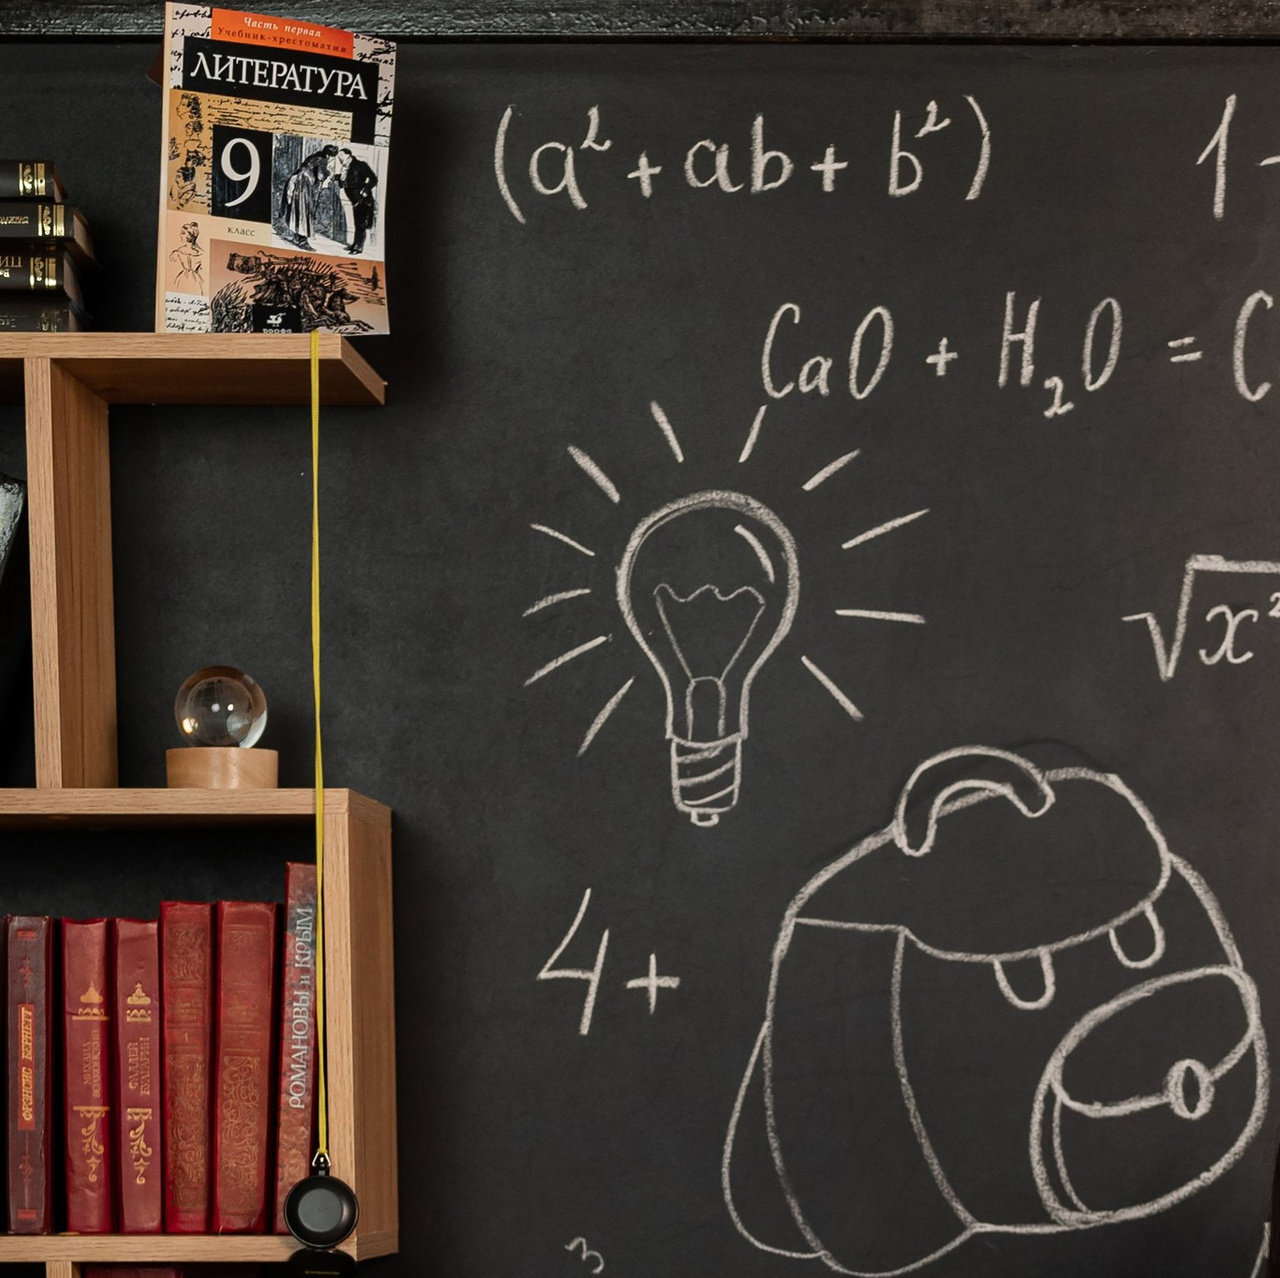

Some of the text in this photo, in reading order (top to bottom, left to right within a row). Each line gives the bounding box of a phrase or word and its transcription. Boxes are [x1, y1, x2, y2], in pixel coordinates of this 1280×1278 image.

[217, 27, 348, 53] Учебник-хрестоматия
[244, 16, 322, 38] Часть первая
[190, 52, 368, 100] ЛИТЕРАТУРА
[219, 137, 260, 207] 9
[227, 226, 255, 237] класс
[294, 907, 313, 969] КРЫМ
[22, 1006, 33, 1122] ФРЭНСИС БЕРНЕТТ
[289, 990, 310, 1109] РОМАНОВЫ
